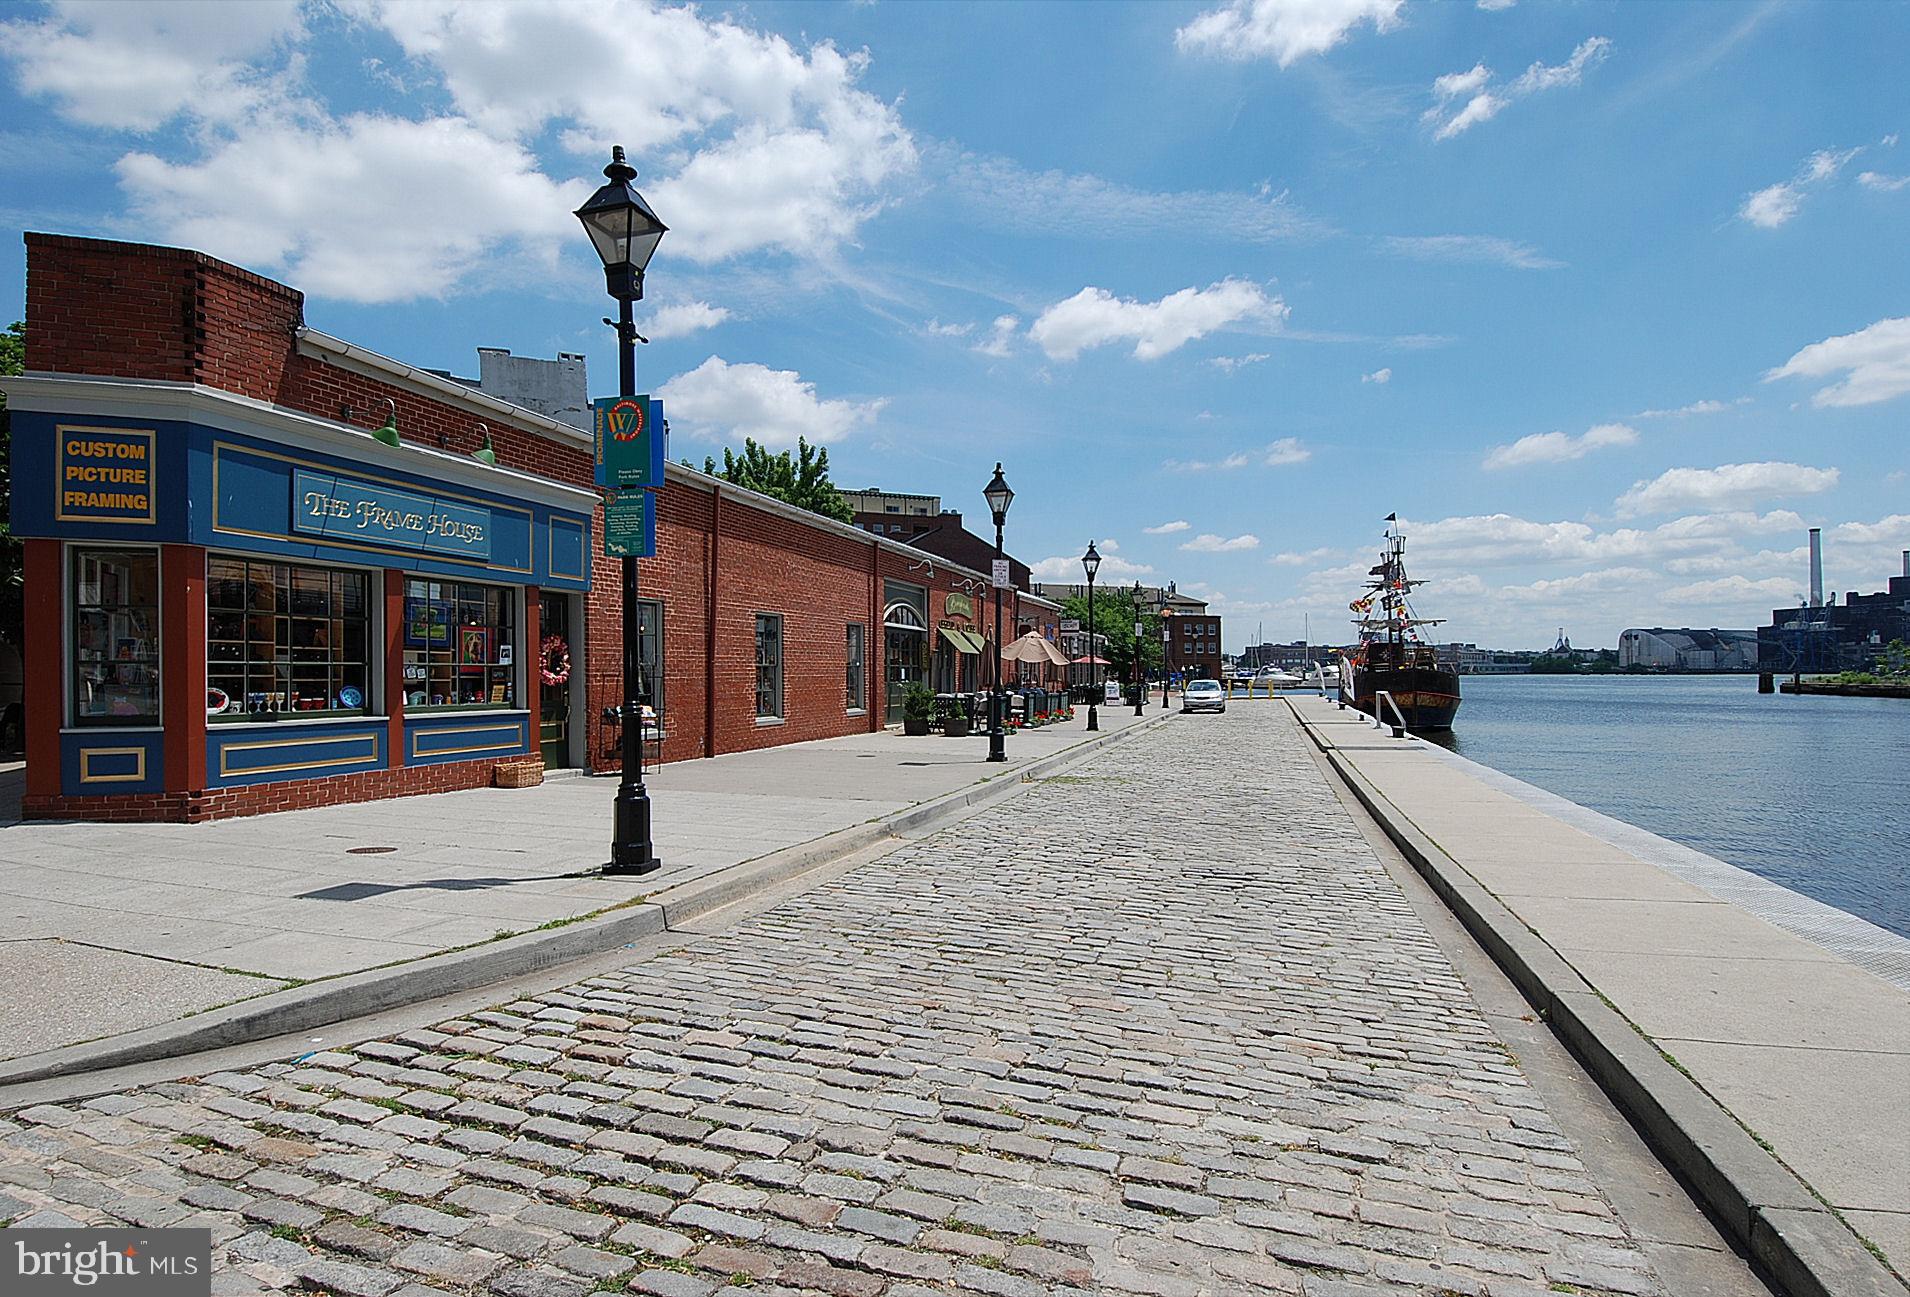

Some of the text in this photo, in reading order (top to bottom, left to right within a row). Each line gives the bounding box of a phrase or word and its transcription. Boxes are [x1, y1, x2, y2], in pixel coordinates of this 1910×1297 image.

[66, 440, 145, 459] CUSTOM
[66, 466, 146, 484] PICTURE
[64, 491, 147, 510] FRAMING
